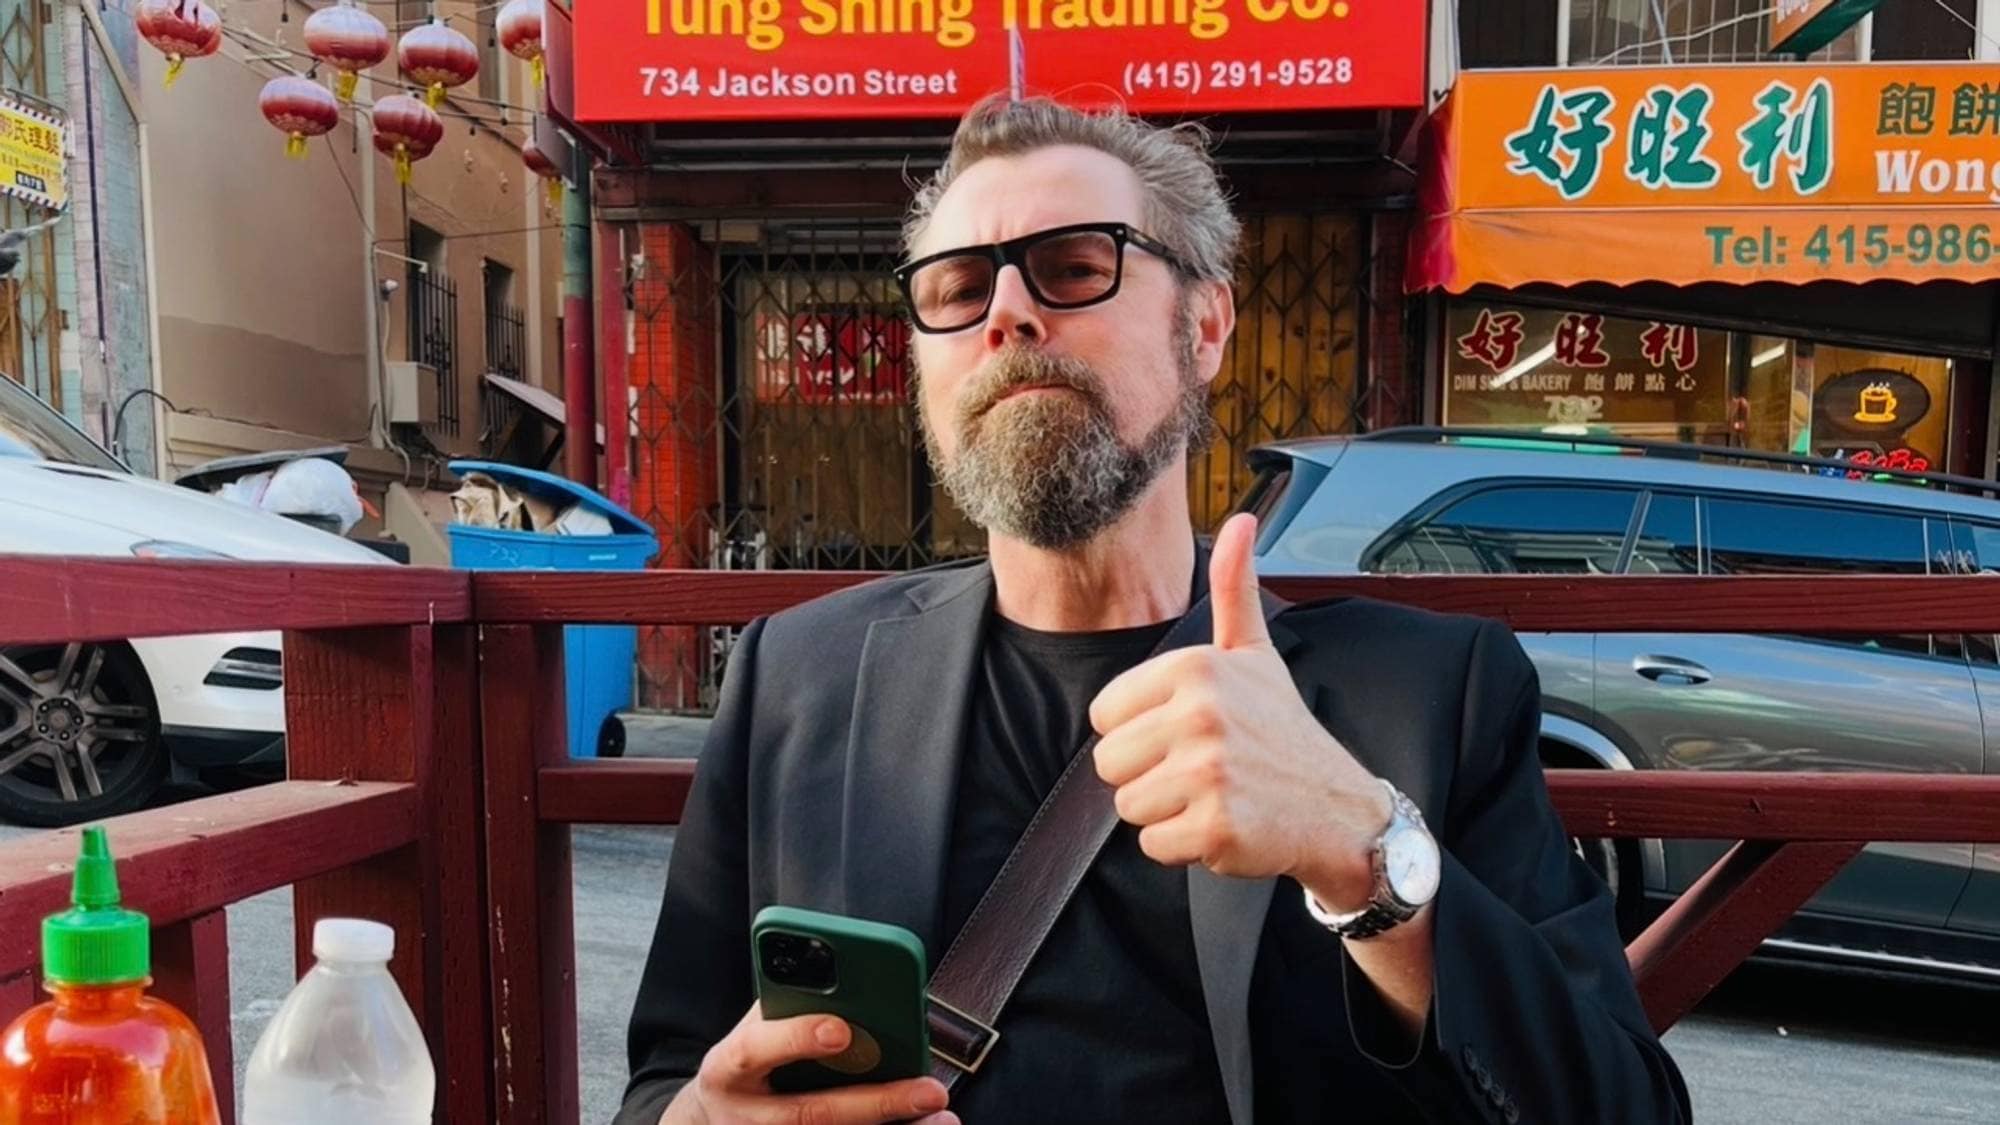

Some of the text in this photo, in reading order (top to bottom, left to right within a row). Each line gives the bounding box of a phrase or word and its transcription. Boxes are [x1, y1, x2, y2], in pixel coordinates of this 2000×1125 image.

[639, 67, 957, 97] 734 Jackson Street
[1123, 57, 1353, 95] (415) 291-9528
[1504, 77, 1833, 200] 好旺利
[1705, 225, 1787, 265] Tel:
[1457, 308, 1698, 372] 好旺利
[1454, 374, 1477, 391] DIM
[1522, 374, 1573, 391] BAKERY
